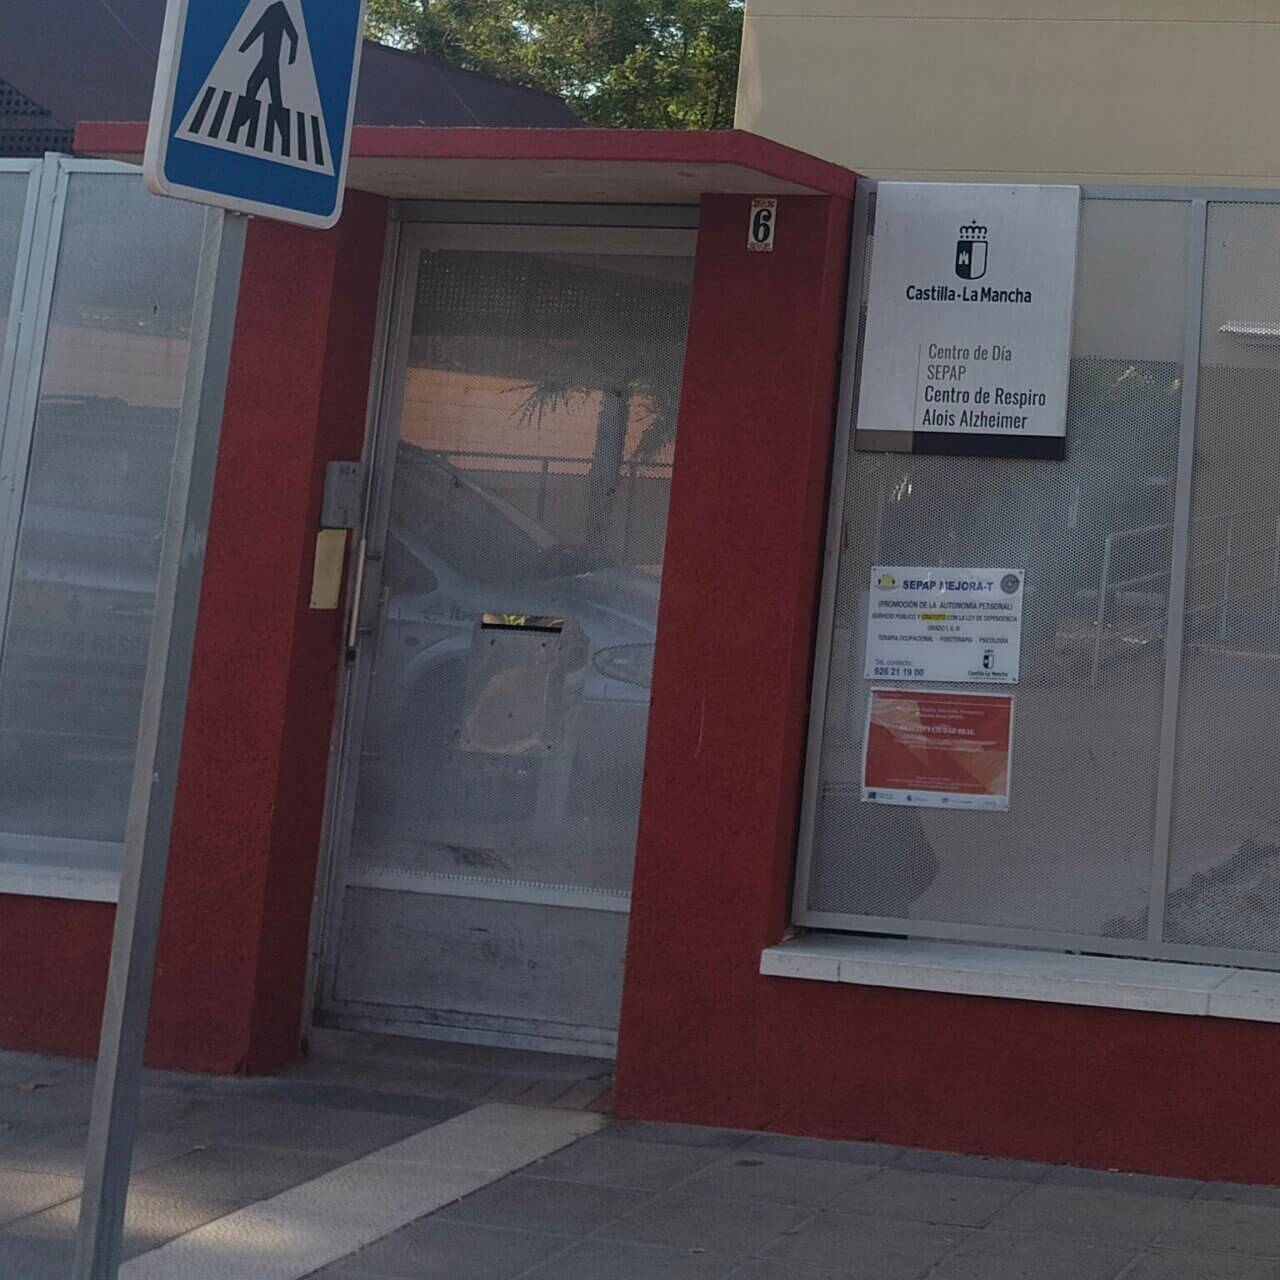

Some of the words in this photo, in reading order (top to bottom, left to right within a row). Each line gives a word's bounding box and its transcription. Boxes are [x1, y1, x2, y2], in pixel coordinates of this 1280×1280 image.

[753, 208, 772, 243] 6
[980, 287, 1032, 304] Mancha
[929, 344, 969, 362] Centro
[973, 345, 989, 362] de
[992, 345, 1012, 362] Día
[927, 365, 966, 382] SEPAP
[925, 385, 969, 404] Centro
[974, 387, 991, 405] de
[994, 388, 1046, 409] Respiro
[922, 408, 955, 427] Alois
[960, 409, 1028, 430] Alzheimer
[903, 579, 937, 591] SEPAP
[938, 580, 994, 592] MEJORA-T
